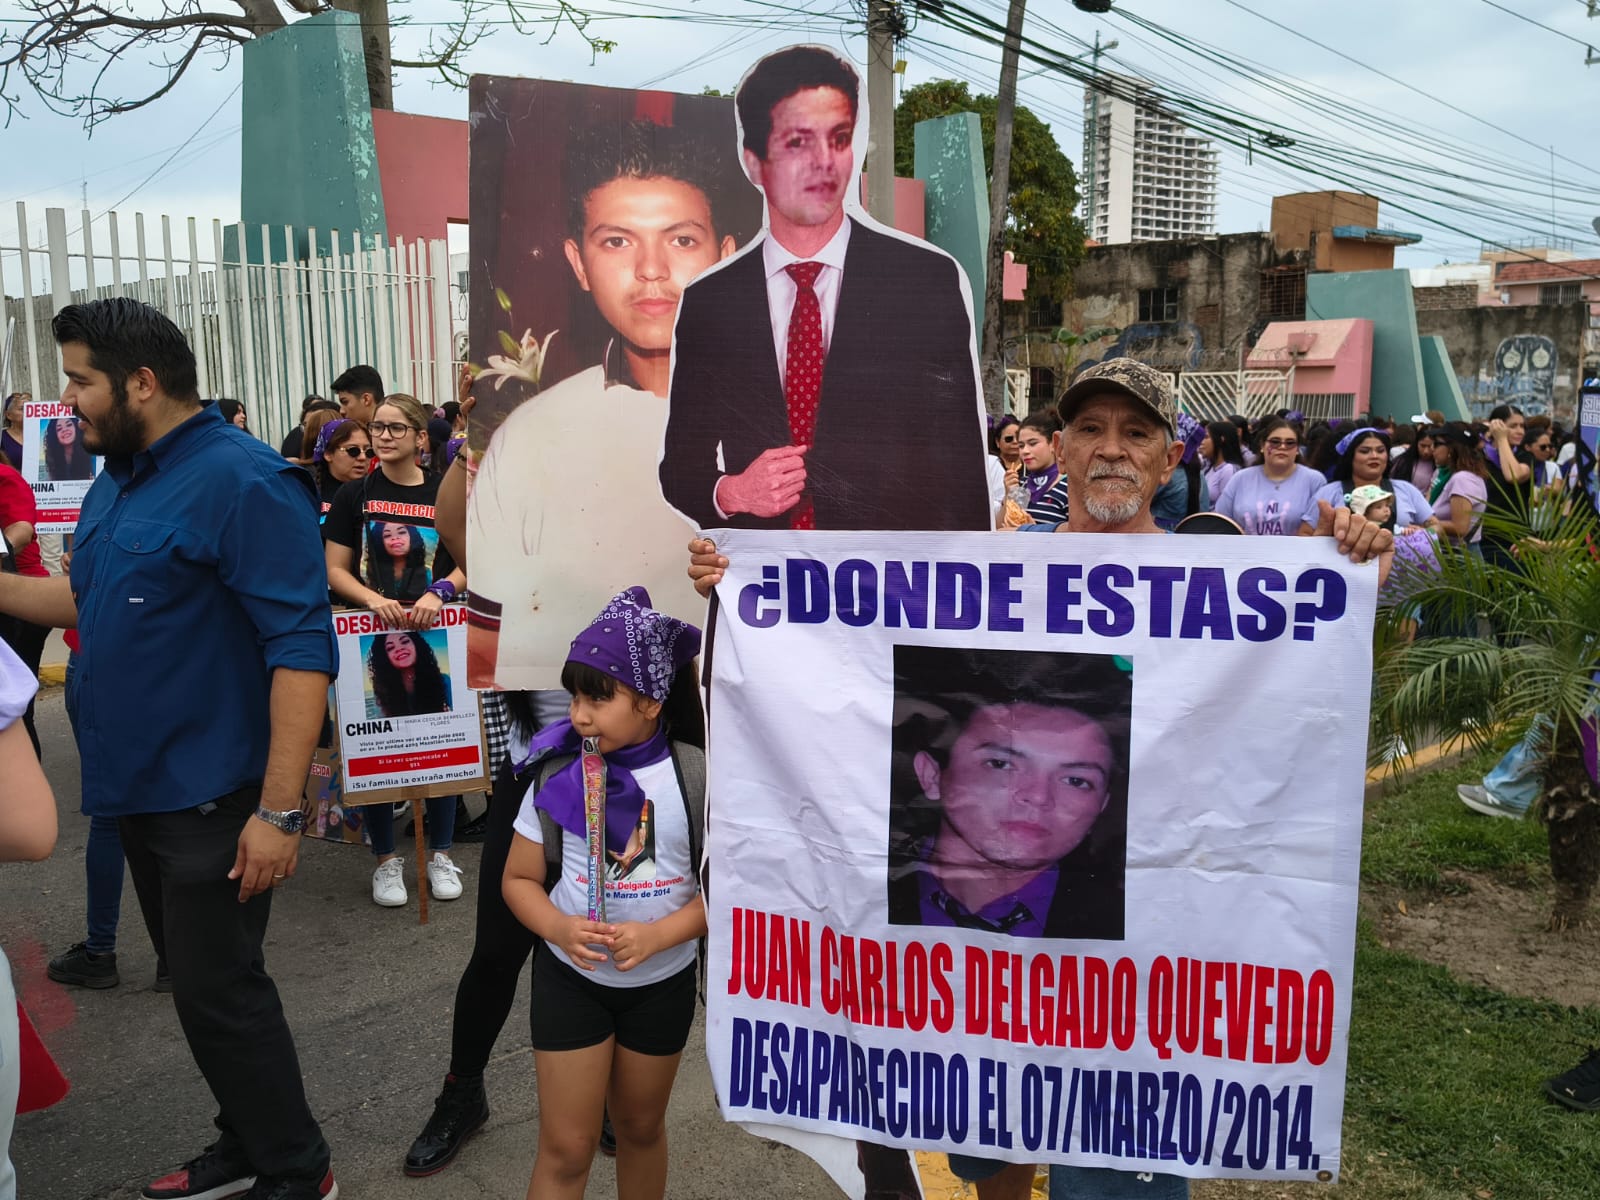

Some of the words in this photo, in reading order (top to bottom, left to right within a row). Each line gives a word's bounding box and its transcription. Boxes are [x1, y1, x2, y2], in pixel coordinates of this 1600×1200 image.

[25, 403, 74, 418] DESAPA
[1266, 503, 1279, 514] NI
[1256, 521, 1283, 535] UNA
[739, 559, 1023, 632] ¿DONDE
[1047, 564, 1347, 642] ESTAS?
[336, 608, 468, 635] DESACIDA
[346, 720, 393, 736] CHINA
[369, 778, 399, 788] familia
[401, 776, 410, 784] la
[411, 773, 444, 783] extraña
[446, 769, 477, 779] mucho!
[576, 873, 589, 884] Jua
[617, 881, 653, 891] Delgado
[655, 875, 685, 888] Quevedo
[613, 891, 638, 899] Marzo
[640, 890, 651, 898] de
[653, 888, 671, 897] 2014
[728, 907, 811, 1008] JUAN
[821, 925, 955, 1034] CARLOS
[965, 946, 1137, 1052] DELGADO
[1148, 955, 1335, 1066] QUEVEDO
[730, 1017, 969, 1145] DESAPARECIDO
[979, 1057, 1012, 1150] EL
[1021, 1062, 1320, 1171] 07/MARZO/2014.
